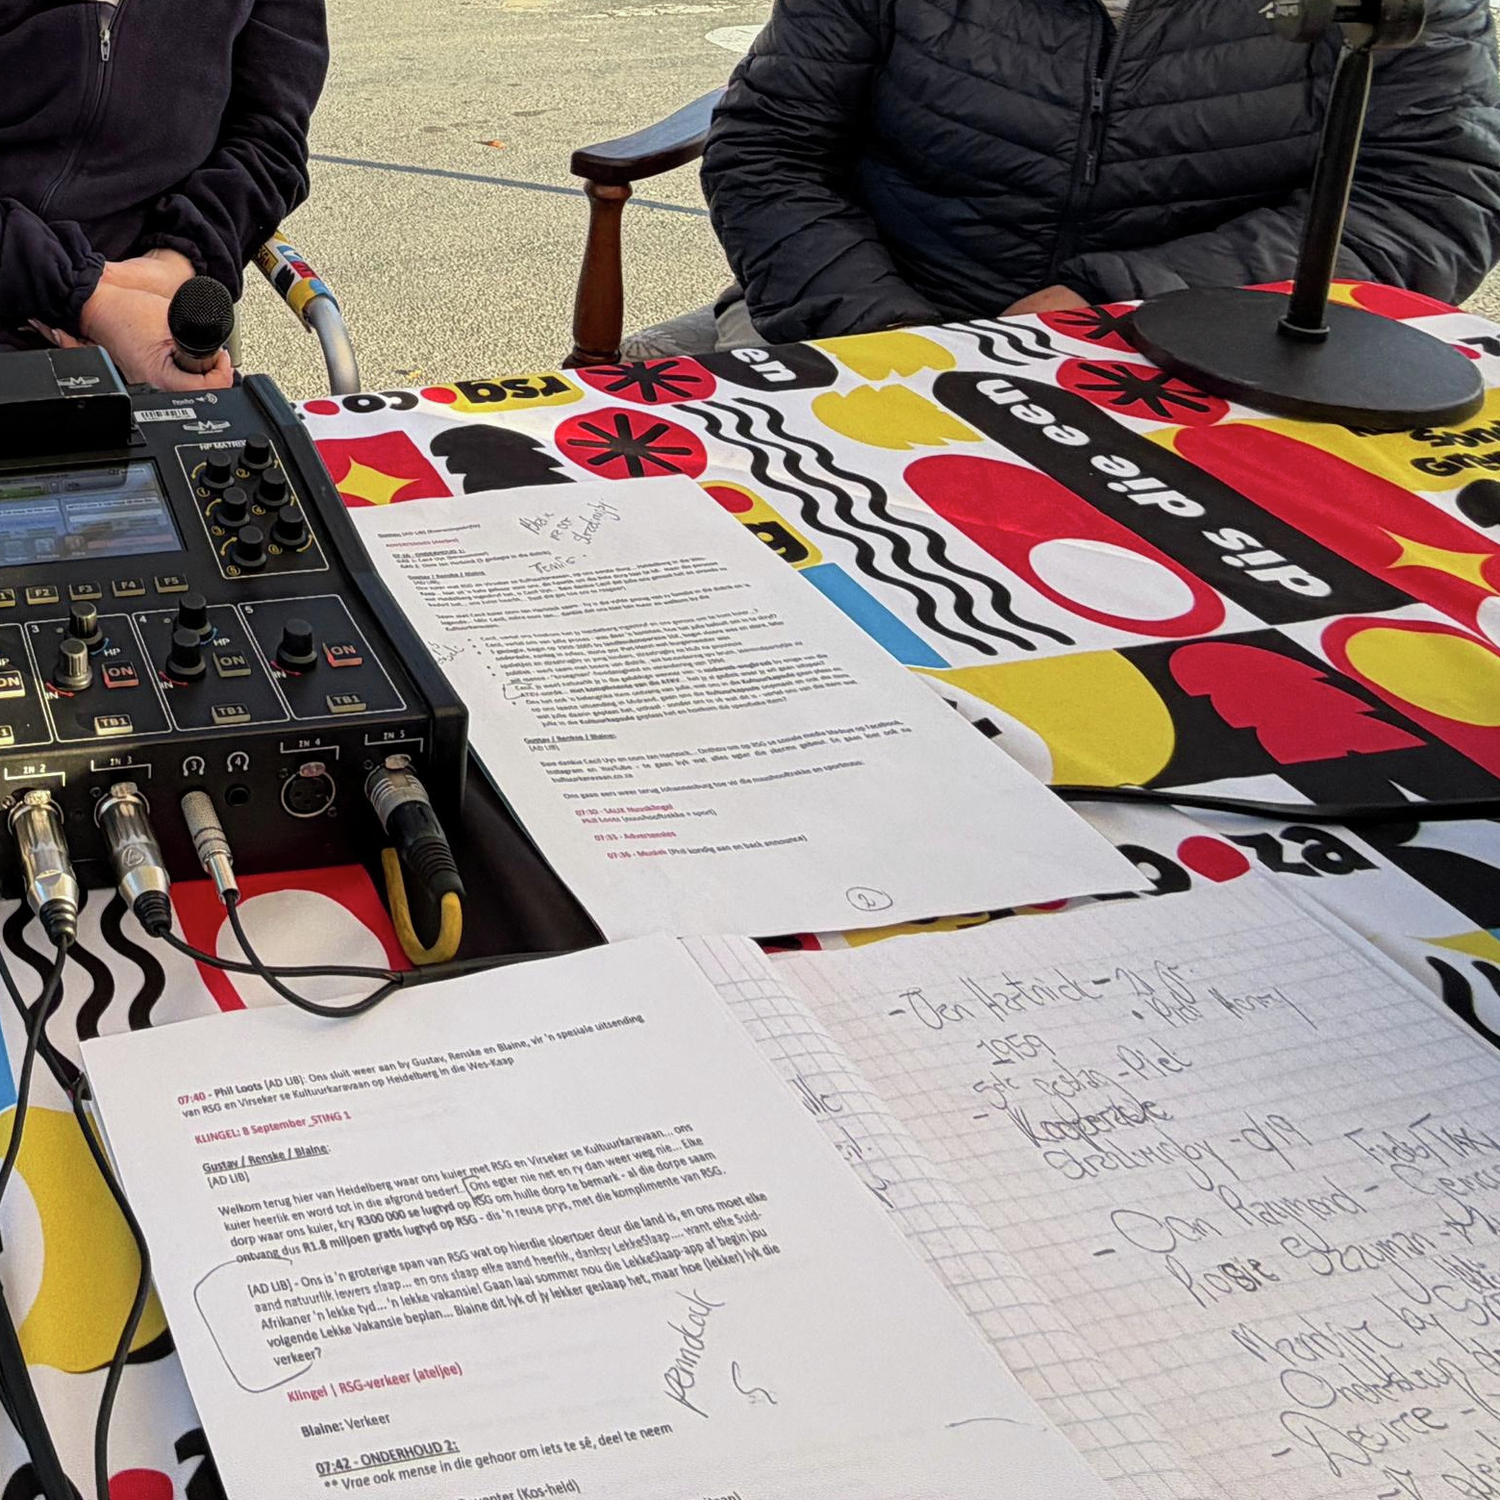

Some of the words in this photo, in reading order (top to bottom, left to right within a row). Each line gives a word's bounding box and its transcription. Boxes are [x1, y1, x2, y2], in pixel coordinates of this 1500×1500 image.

[975, 379, 1090, 446] een
[1090, 454, 1206, 518] die
[1202, 526, 1332, 597] dis
[121, 580, 136, 589] F4
[165, 577, 180, 586] F5
[35, 588, 50, 597] F2
[78, 584, 93, 593] F3
[331, 645, 357, 655] ON
[220, 655, 246, 666] ON
[108, 666, 134, 677] ON
[334, 695, 360, 704] TB1
[218, 707, 245, 716] TB1
[100, 717, 129, 727] TB1
[383, 732, 396, 740] IN
[110, 758, 124, 766] IN
[23, 766, 36, 774] IN
[193, 1128, 241, 1144] KLINGEL:
[240, 1125, 250, 1136] 8
[342, 1110, 352, 1120] 1
[216, 1201, 262, 1217] Welkom
[261, 1196, 292, 1209] terug
[291, 1192, 313, 1205] hier
[314, 1189, 335, 1201] van
[334, 1180, 394, 1197] Heidelberg
[392, 1175, 419, 1188] waar
[420, 1172, 440, 1184] ons
[439, 1168, 470, 1181] kuier
[468, 1163, 491, 1179] met
[489, 1159, 513, 1172] RSG
[512, 1159, 528, 1169] en
[525, 1150, 569, 1166] Virseker
[569, 1148, 584, 1158] se
[672, 1123, 693, 1135] ons
[272, 1346, 322, 1366] verkeer?
[299, 1421, 345, 1438] Blaine:
[342, 1413, 390, 1430] Verkeer
[339, 1475, 371, 1490] Vrae
[372, 1468, 396, 1485] ook
[397, 1463, 437, 1480] mense
[438, 1459, 453, 1473] in
[452, 1456, 473, 1470] die
[474, 1450, 516, 1469] gehoor
[518, 1447, 540, 1459] om
[539, 1442, 563, 1455] iets
[562, 1440, 577, 1452] te
[597, 1430, 624, 1447] deel
[623, 1430, 638, 1442] te
[638, 1423, 673, 1439] neem
[359, 1441, 443, 1466] ONDERHOUD
[442, 1439, 459, 1452] 2:
